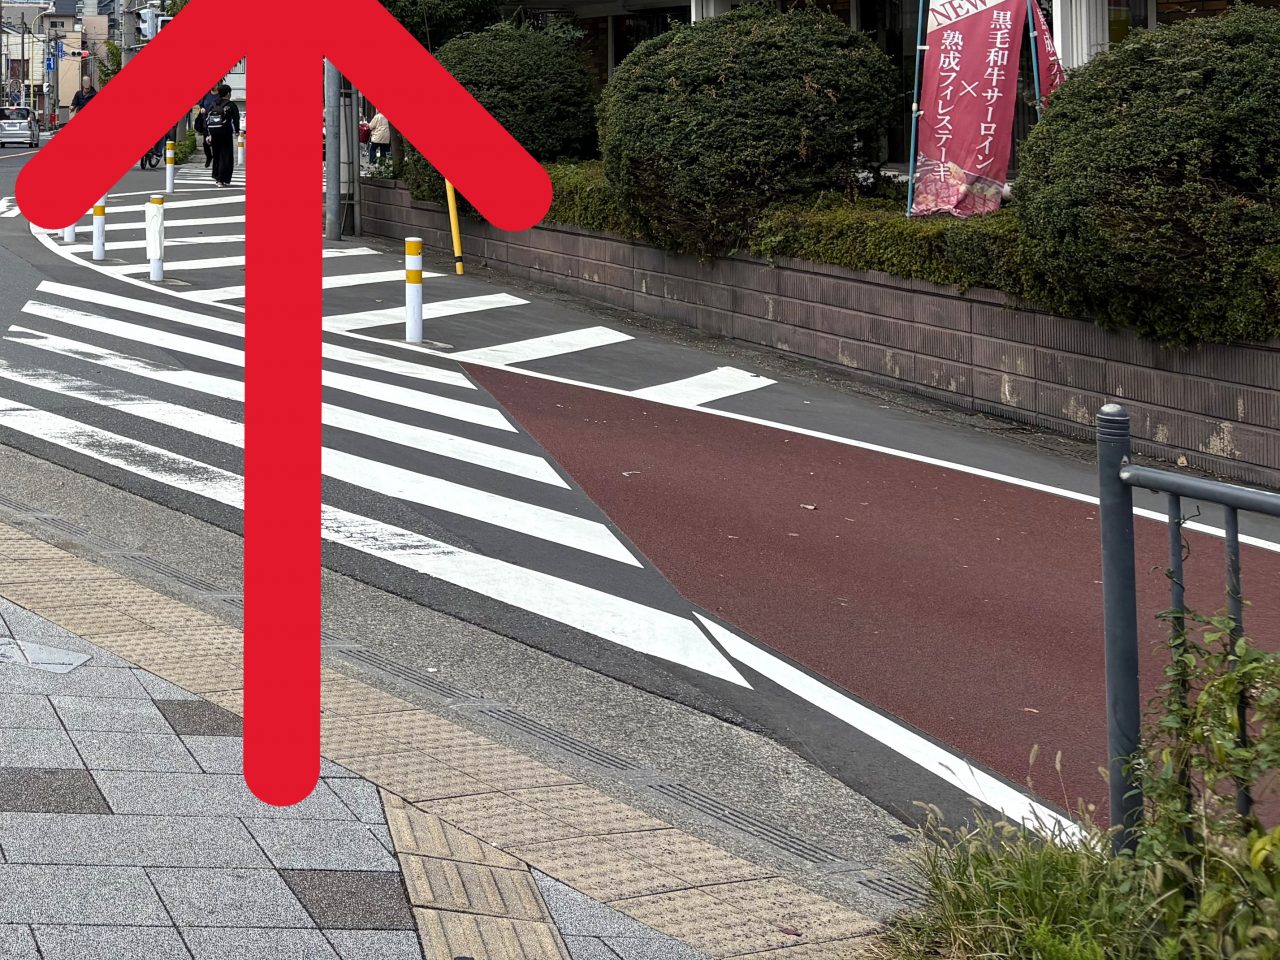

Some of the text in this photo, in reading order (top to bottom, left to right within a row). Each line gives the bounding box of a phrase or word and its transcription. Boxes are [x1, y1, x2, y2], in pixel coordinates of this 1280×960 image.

[932, 29, 964, 182] 熟成フィレステーキ
[975, 9, 1013, 170] 黒毛和牛サーロイン
